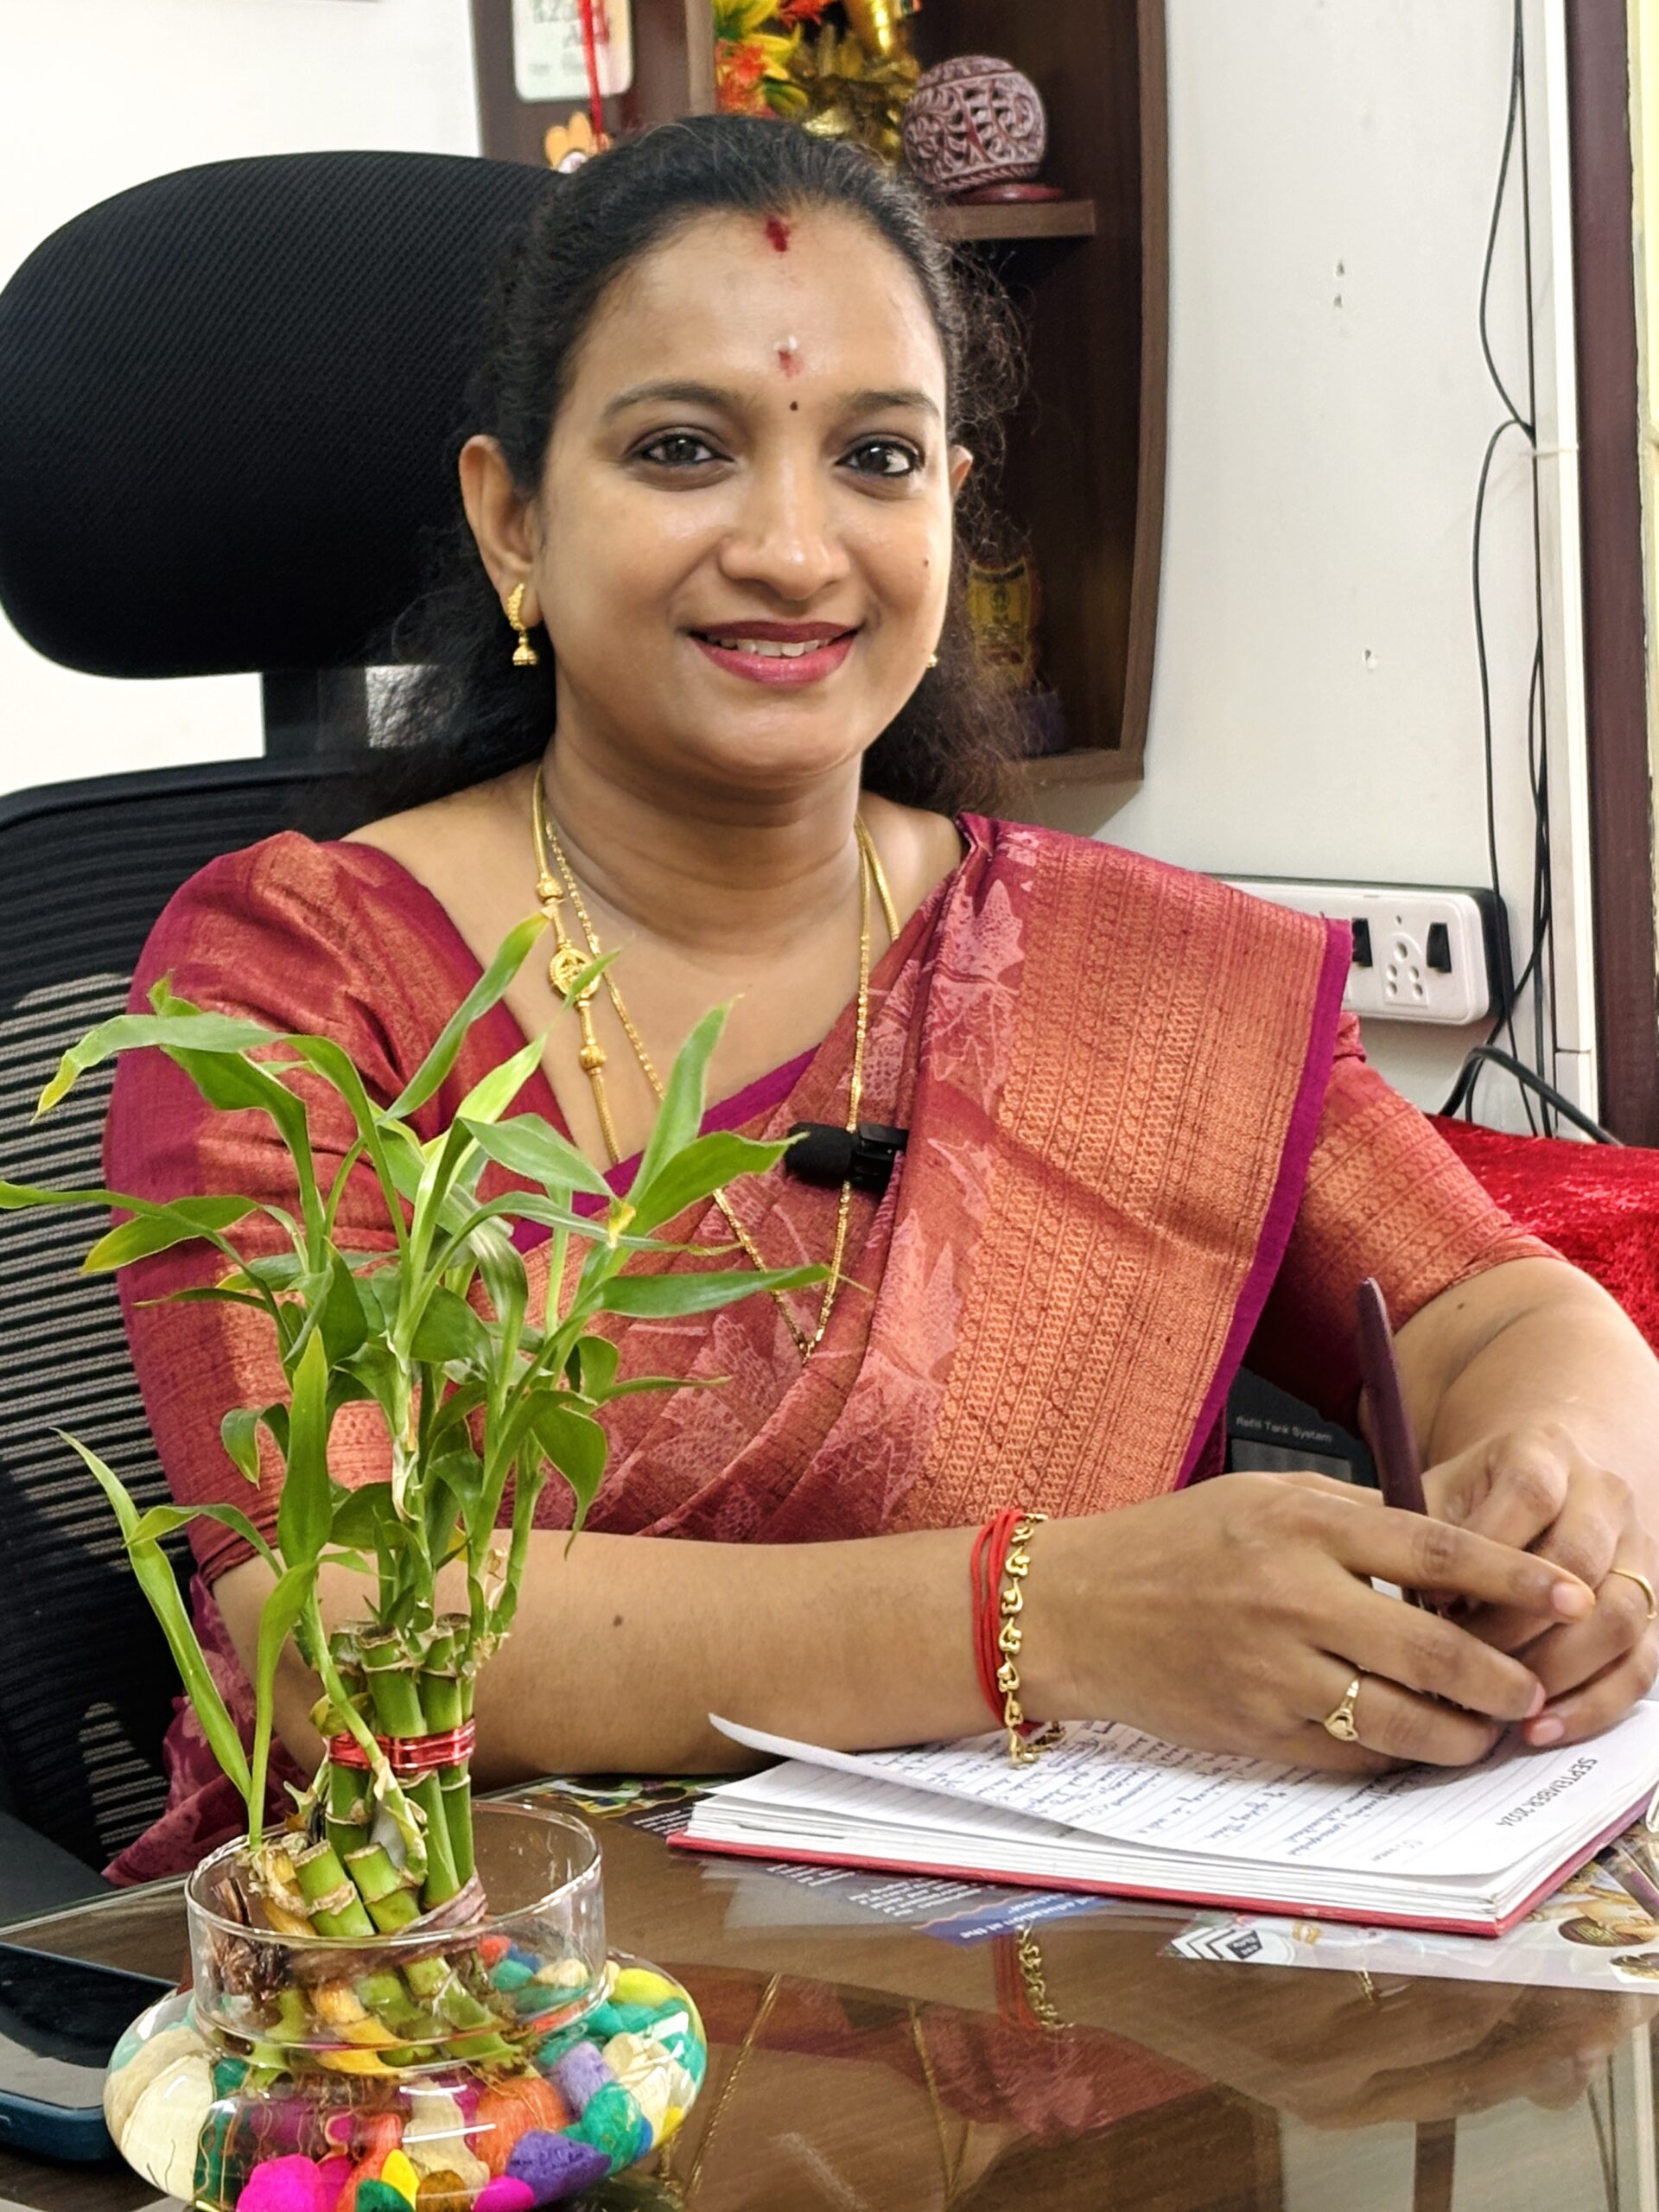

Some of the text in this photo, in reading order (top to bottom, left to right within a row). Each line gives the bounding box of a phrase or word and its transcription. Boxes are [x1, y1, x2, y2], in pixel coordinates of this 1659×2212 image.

[1264, 1421, 1290, 1434] Tank
[1292, 1427, 1332, 1443] System
[1496, 1757, 1598, 1827] SEPTEMBER 2024
